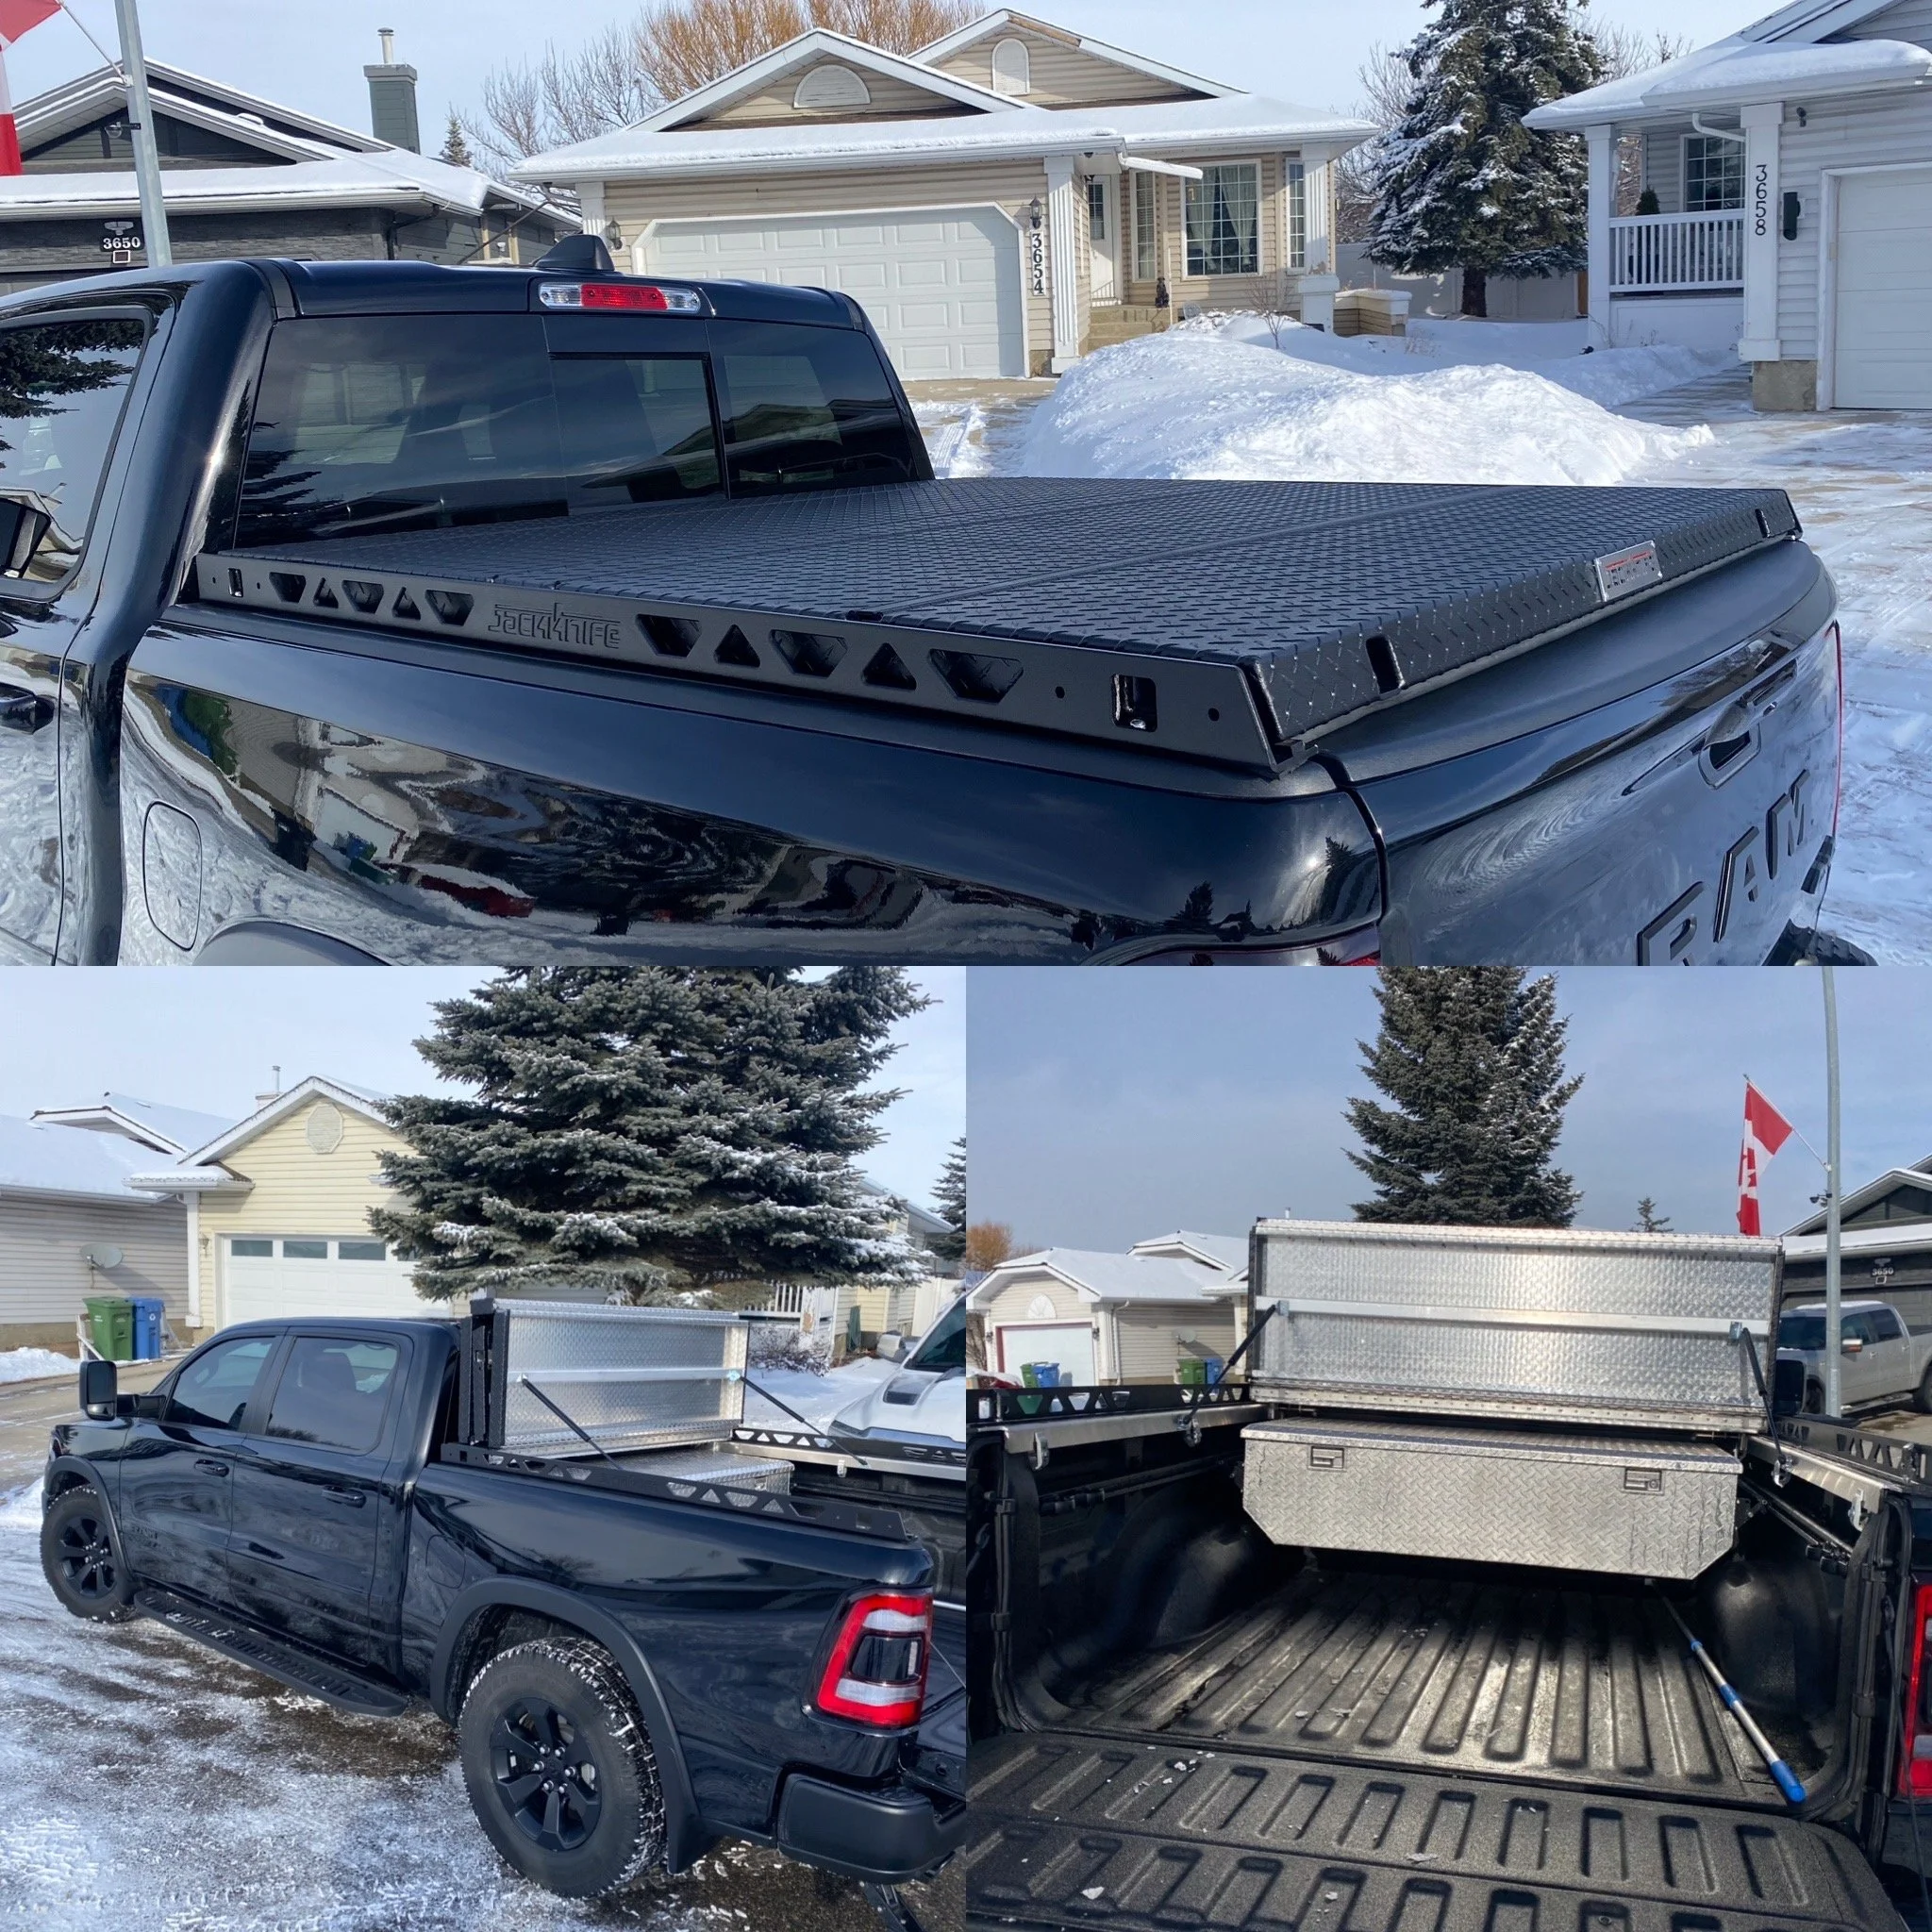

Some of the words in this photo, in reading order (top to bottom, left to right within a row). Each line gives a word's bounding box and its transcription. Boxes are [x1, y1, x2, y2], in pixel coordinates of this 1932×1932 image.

[1755, 164, 1768, 236] 3658
[103, 236, 142, 249] 3650
[1032, 232, 1044, 294] 3654
